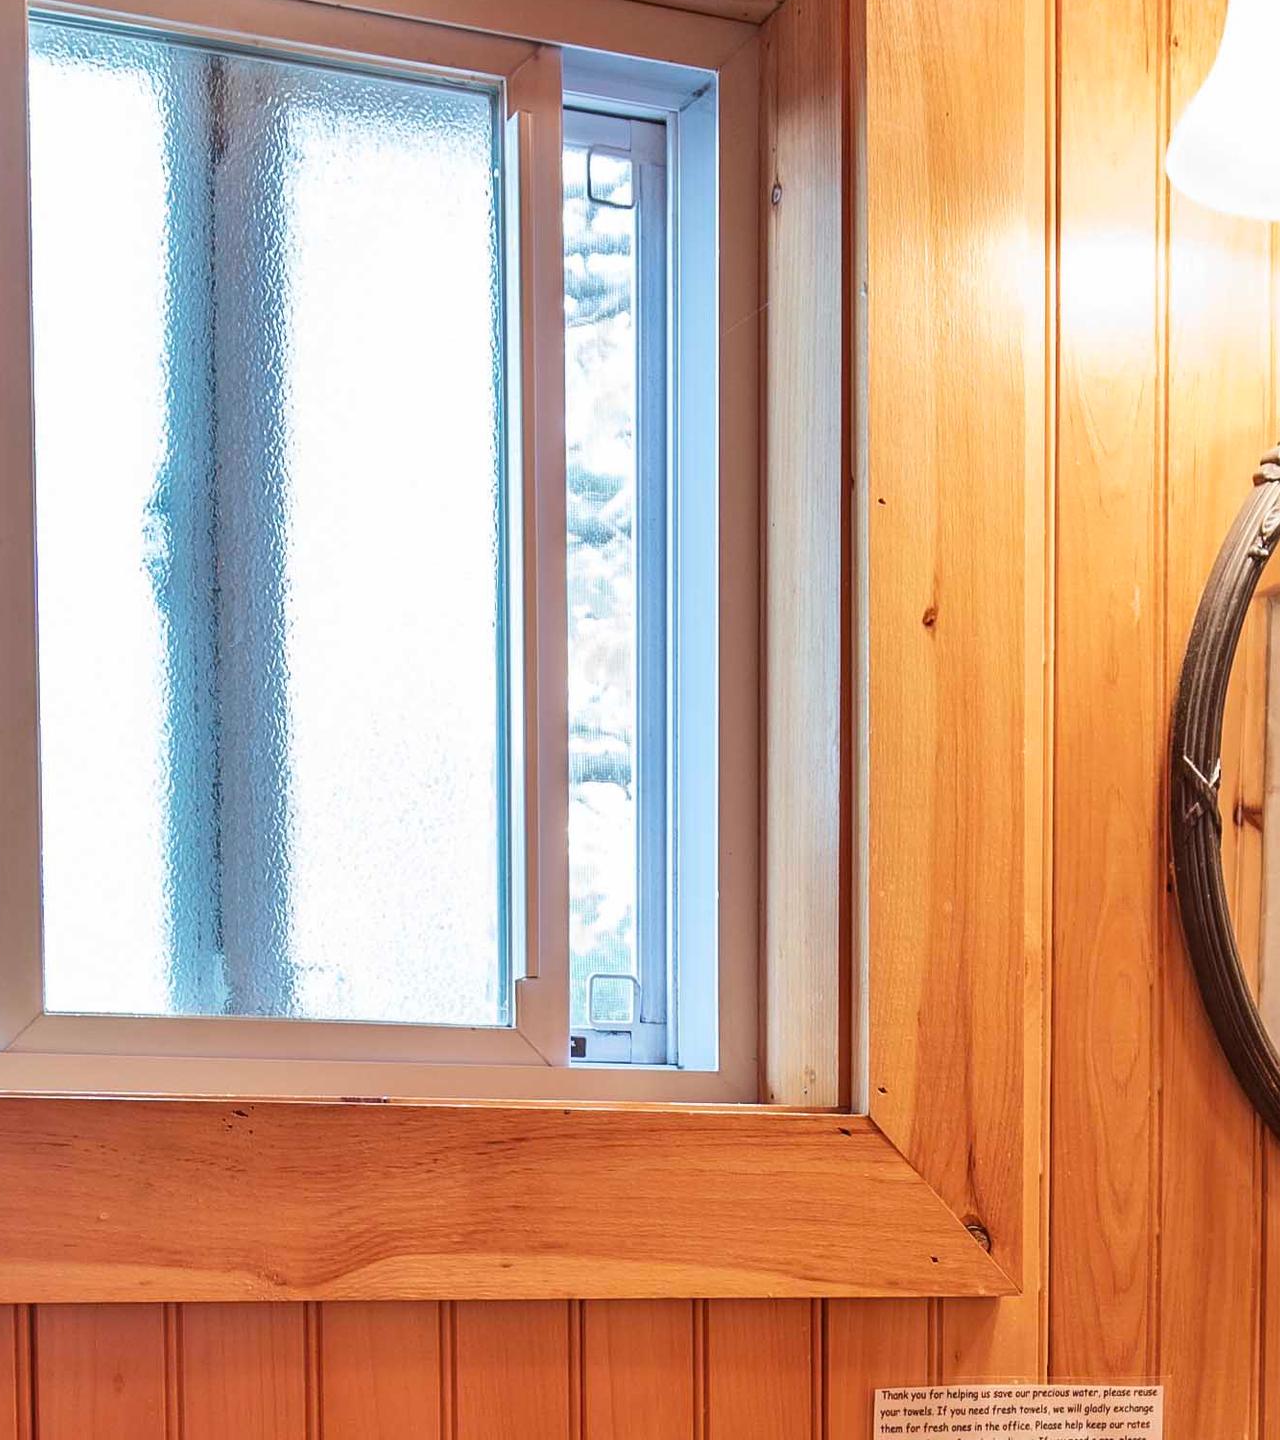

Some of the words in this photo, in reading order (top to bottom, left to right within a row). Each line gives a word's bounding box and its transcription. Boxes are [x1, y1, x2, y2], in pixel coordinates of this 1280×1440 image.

[882, 1391, 908, 1400] Thank
[911, 1392, 926, 1401] you
[929, 1390, 943, 1399] for
[947, 1389, 978, 1401] helping
[1032, 1388, 1069, 1399] precious
[1072, 1389, 1100, 1398] water,
[1104, 1388, 1131, 1399] please
[1134, 1388, 1157, 1396] reuse
[880, 1408, 899, 1419] your
[937, 1406, 947, 1416] If
[951, 1408, 966, 1417] you
[969, 1406, 989, 1415] need
[992, 1405, 1017, 1415] fresh
[1020, 1405, 1051, 1415] towels,
[1068, 1404, 1082, 1413] will
[1085, 1405, 1110, 1415] gladly
[1114, 1404, 1154, 1415] exchange
[881, 1424, 903, 1433] them
[906, 1423, 920, 1432] for
[924, 1422, 948, 1432] fresh
[975, 1423, 982, 1431] in
[985, 1422, 999, 1431] the
[1003, 1421, 1033, 1431] office.
[1035, 1421, 1062, 1430] Please
[1065, 1420, 1083, 1430] help
[1086, 1420, 1106, 1430] keep
